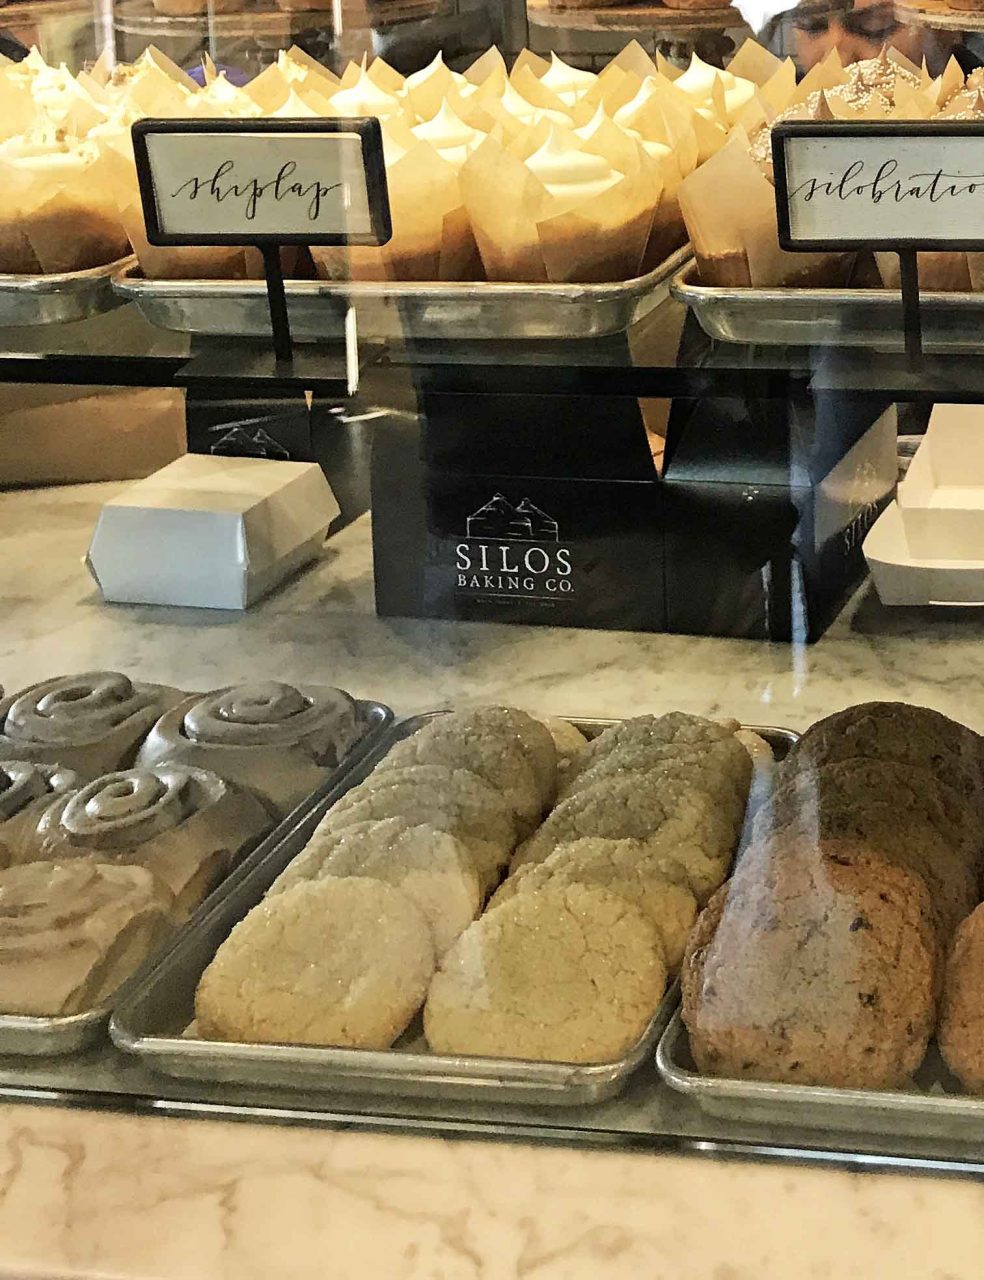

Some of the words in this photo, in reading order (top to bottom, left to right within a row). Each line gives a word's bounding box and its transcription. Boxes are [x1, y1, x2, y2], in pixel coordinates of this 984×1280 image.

[172, 160, 342, 220] shiplap
[456, 544, 572, 575] SILOS
[457, 574, 534, 591] BAKING
[545, 579, 575, 593] CO.
